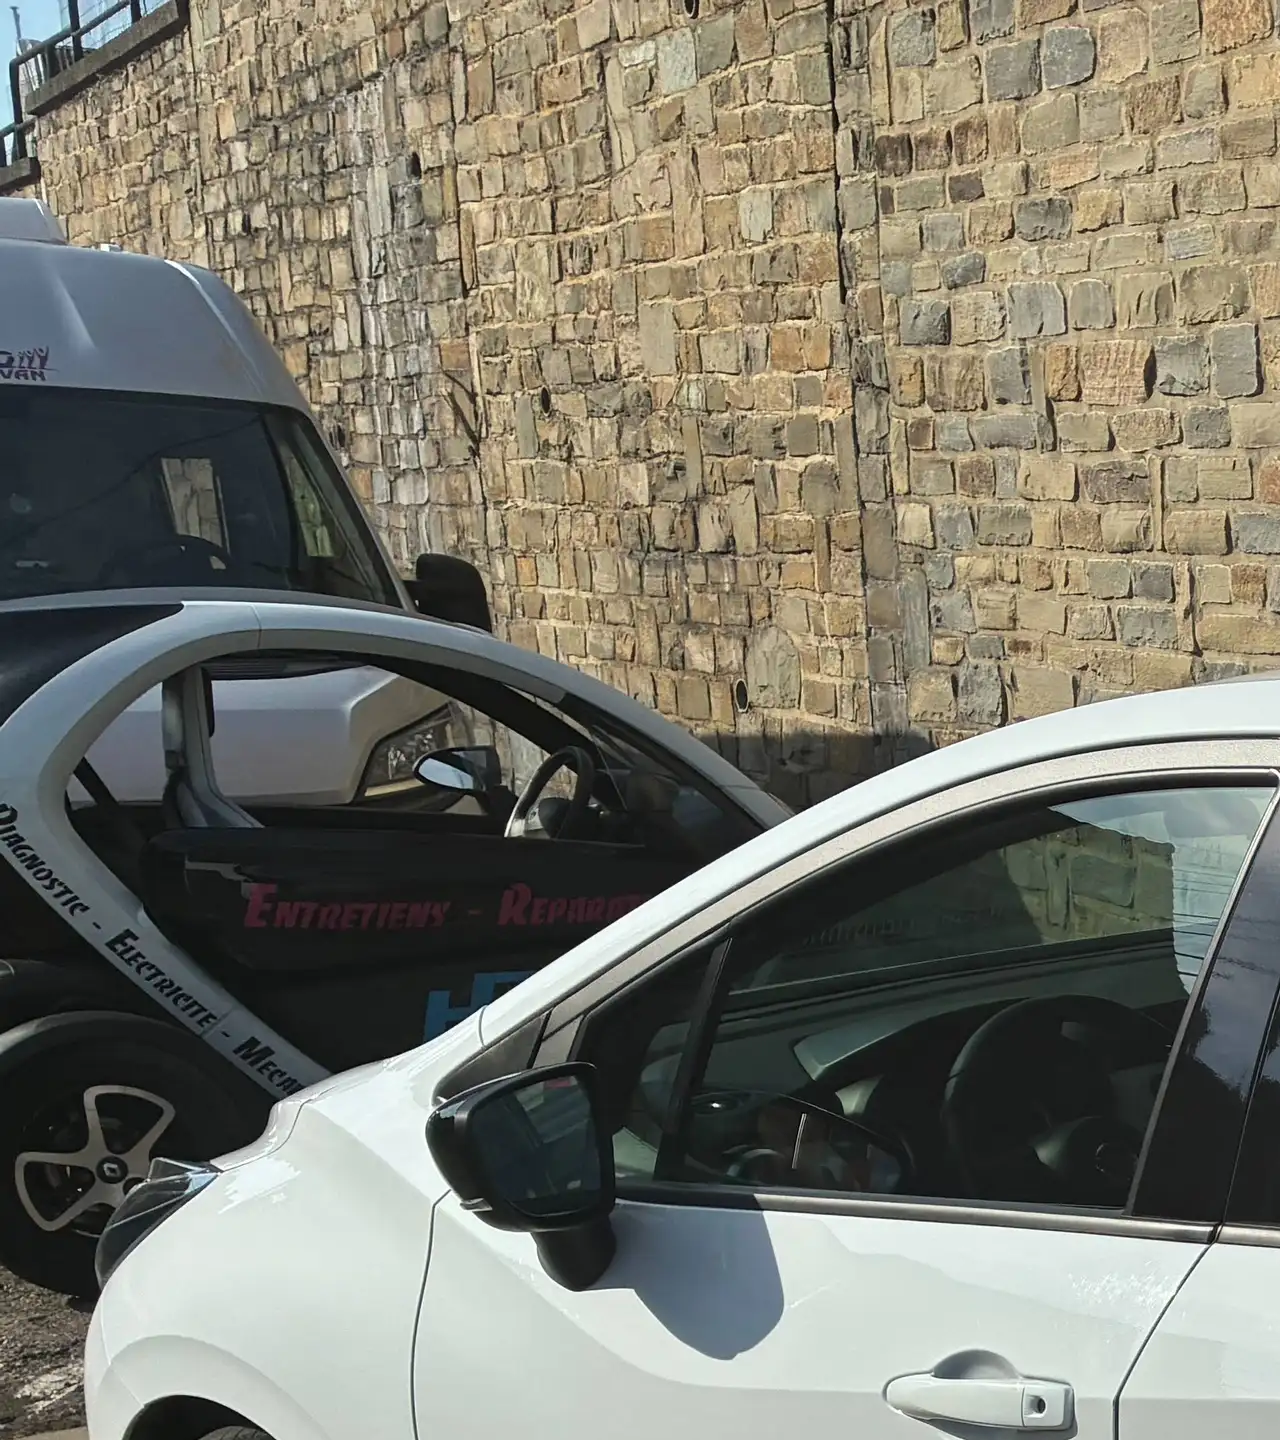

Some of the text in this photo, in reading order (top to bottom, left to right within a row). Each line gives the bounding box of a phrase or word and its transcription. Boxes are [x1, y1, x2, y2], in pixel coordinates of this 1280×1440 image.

[0, 804, 90, 917] DIAGNOSTIC
[104, 928, 218, 1029] ELECTRICITE
[244, 883, 450, 930] ENTRETIENS
